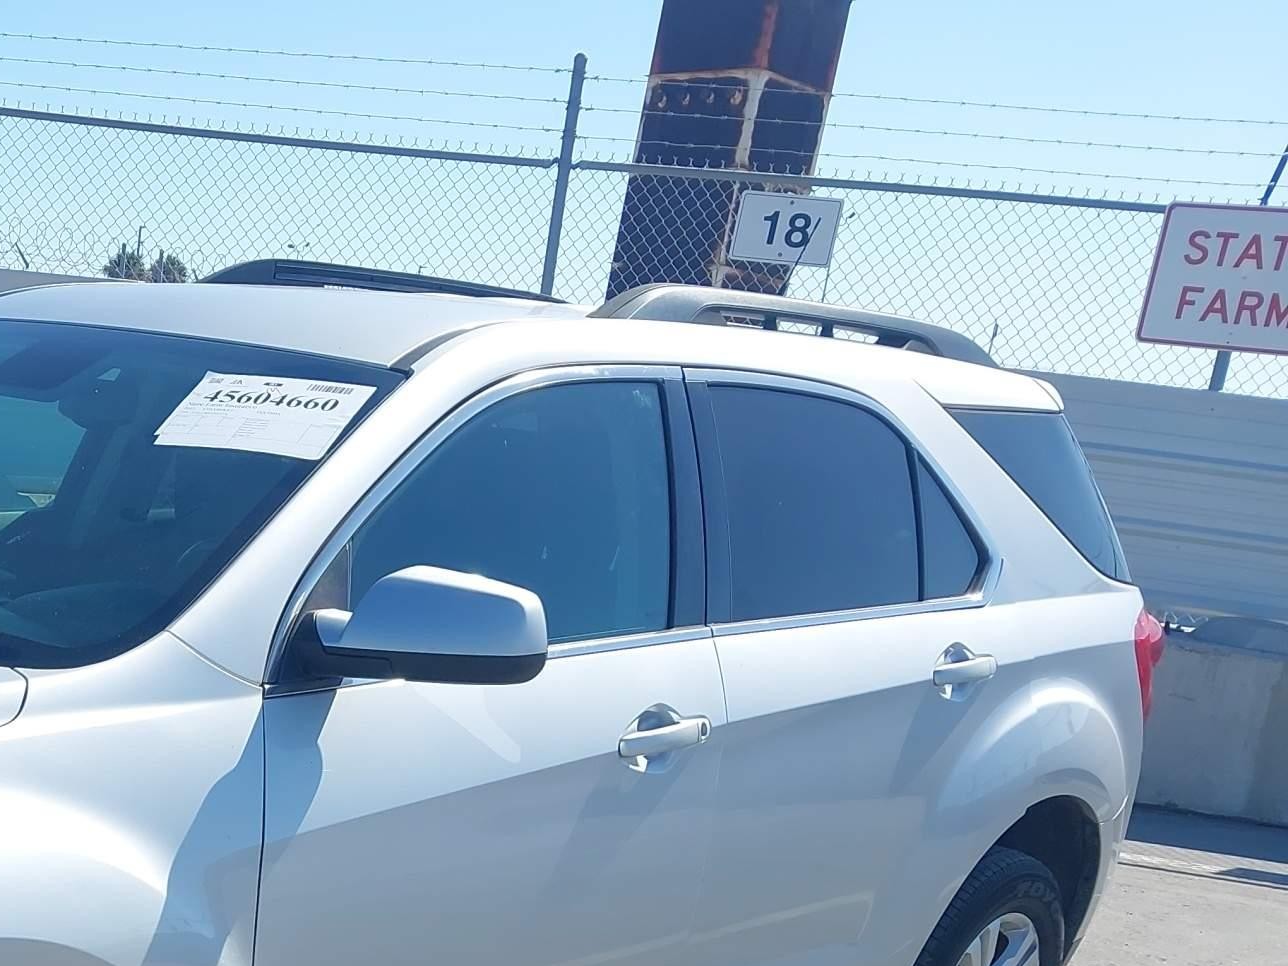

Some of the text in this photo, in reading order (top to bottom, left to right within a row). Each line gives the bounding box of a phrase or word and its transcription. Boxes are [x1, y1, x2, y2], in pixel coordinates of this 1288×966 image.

[763, 210, 812, 248] 18
[1175, 285, 1288, 330] FARM
[203, 388, 340, 412] 45604660
